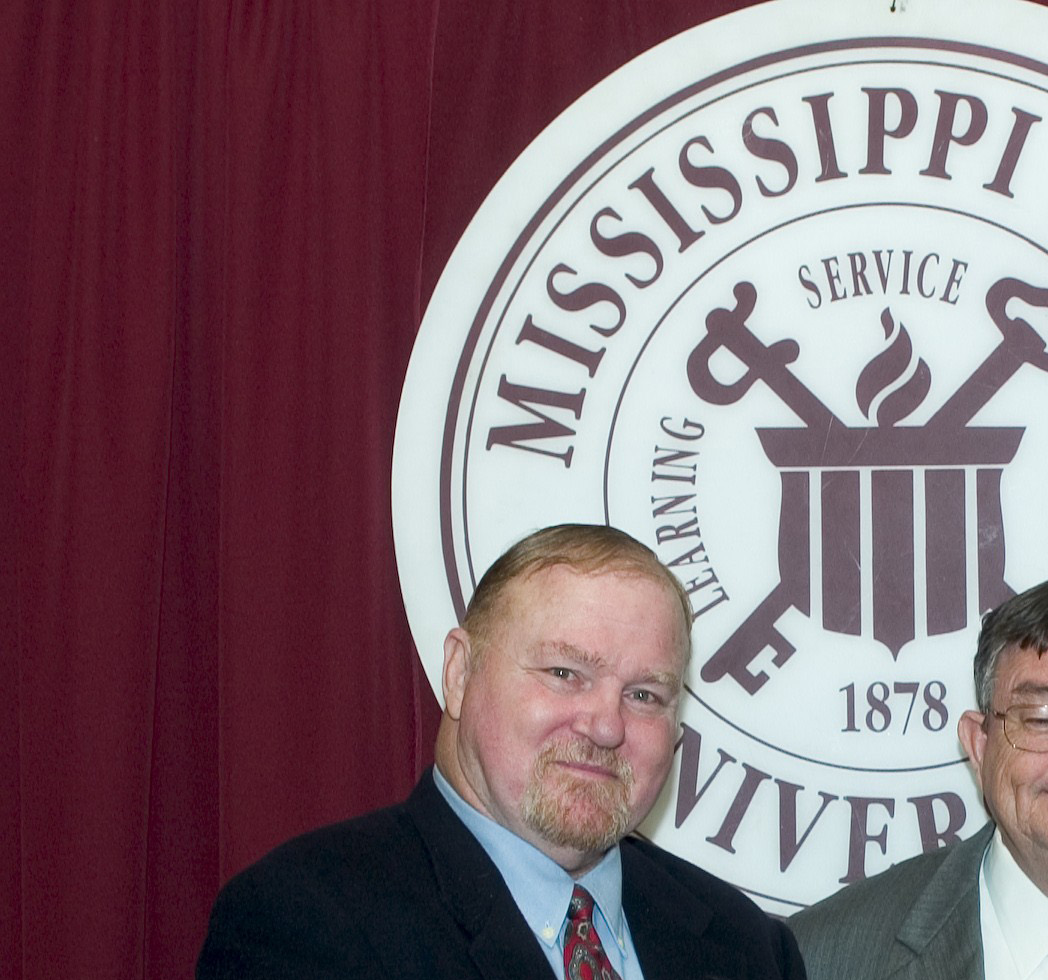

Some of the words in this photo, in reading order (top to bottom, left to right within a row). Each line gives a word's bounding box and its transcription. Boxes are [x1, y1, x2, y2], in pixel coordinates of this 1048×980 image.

[486, 85, 1043, 469] MISSISSIPPI
[798, 249, 968, 310] SERVICE
[651, 416, 730, 622] LEARNING
[838, 680, 948, 735] 1878
[674, 721, 967, 884] NIVER
